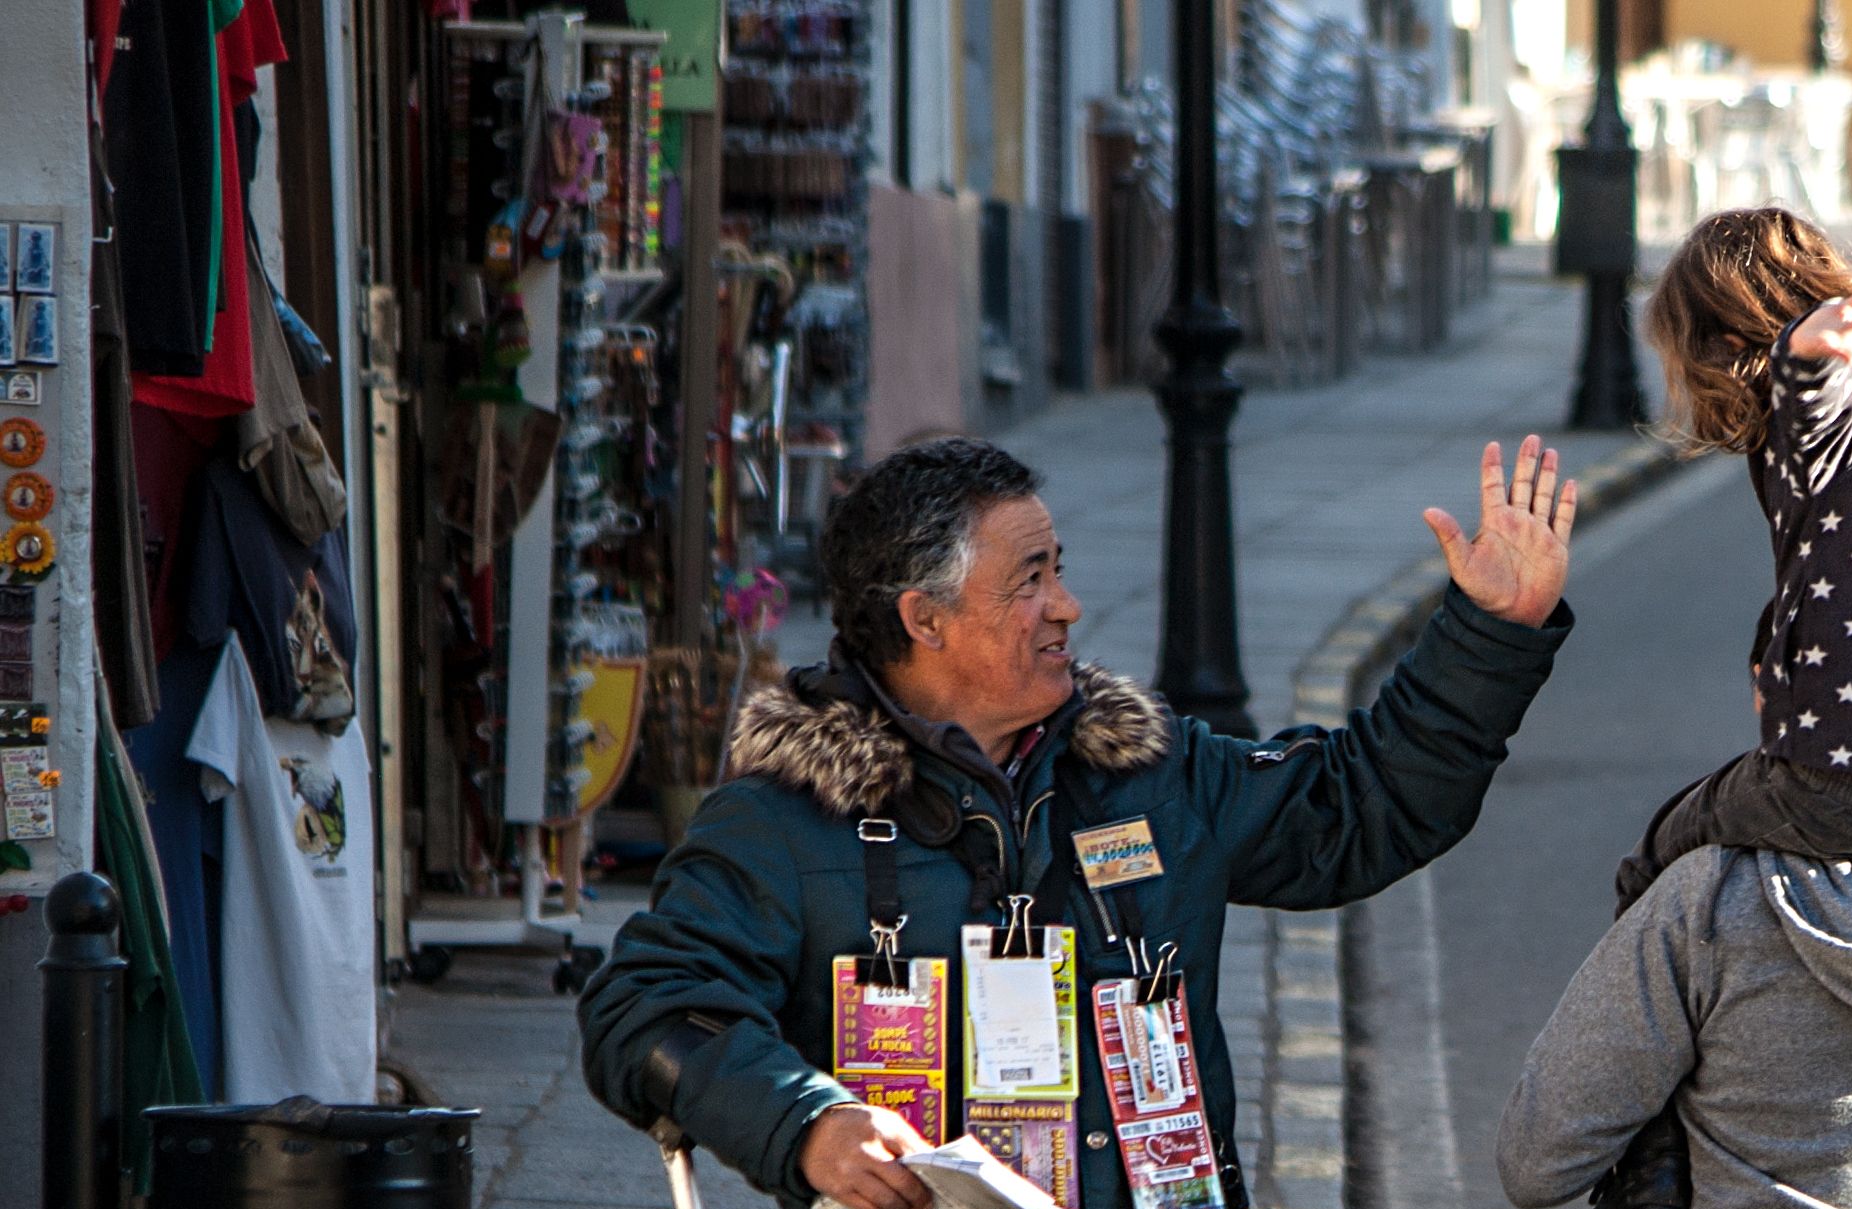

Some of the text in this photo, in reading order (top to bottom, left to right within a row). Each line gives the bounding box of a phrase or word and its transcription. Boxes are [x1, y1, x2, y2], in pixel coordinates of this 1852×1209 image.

[867, 1039, 914, 1053] LA HUCHA
[1152, 1042, 1165, 1084] 19112
[1182, 1060, 1196, 1086] ONCE
[867, 1088, 915, 1105] 60.000€
[968, 1104, 1064, 1121] MILLONARIO
[1165, 1114, 1200, 1131] 71565
